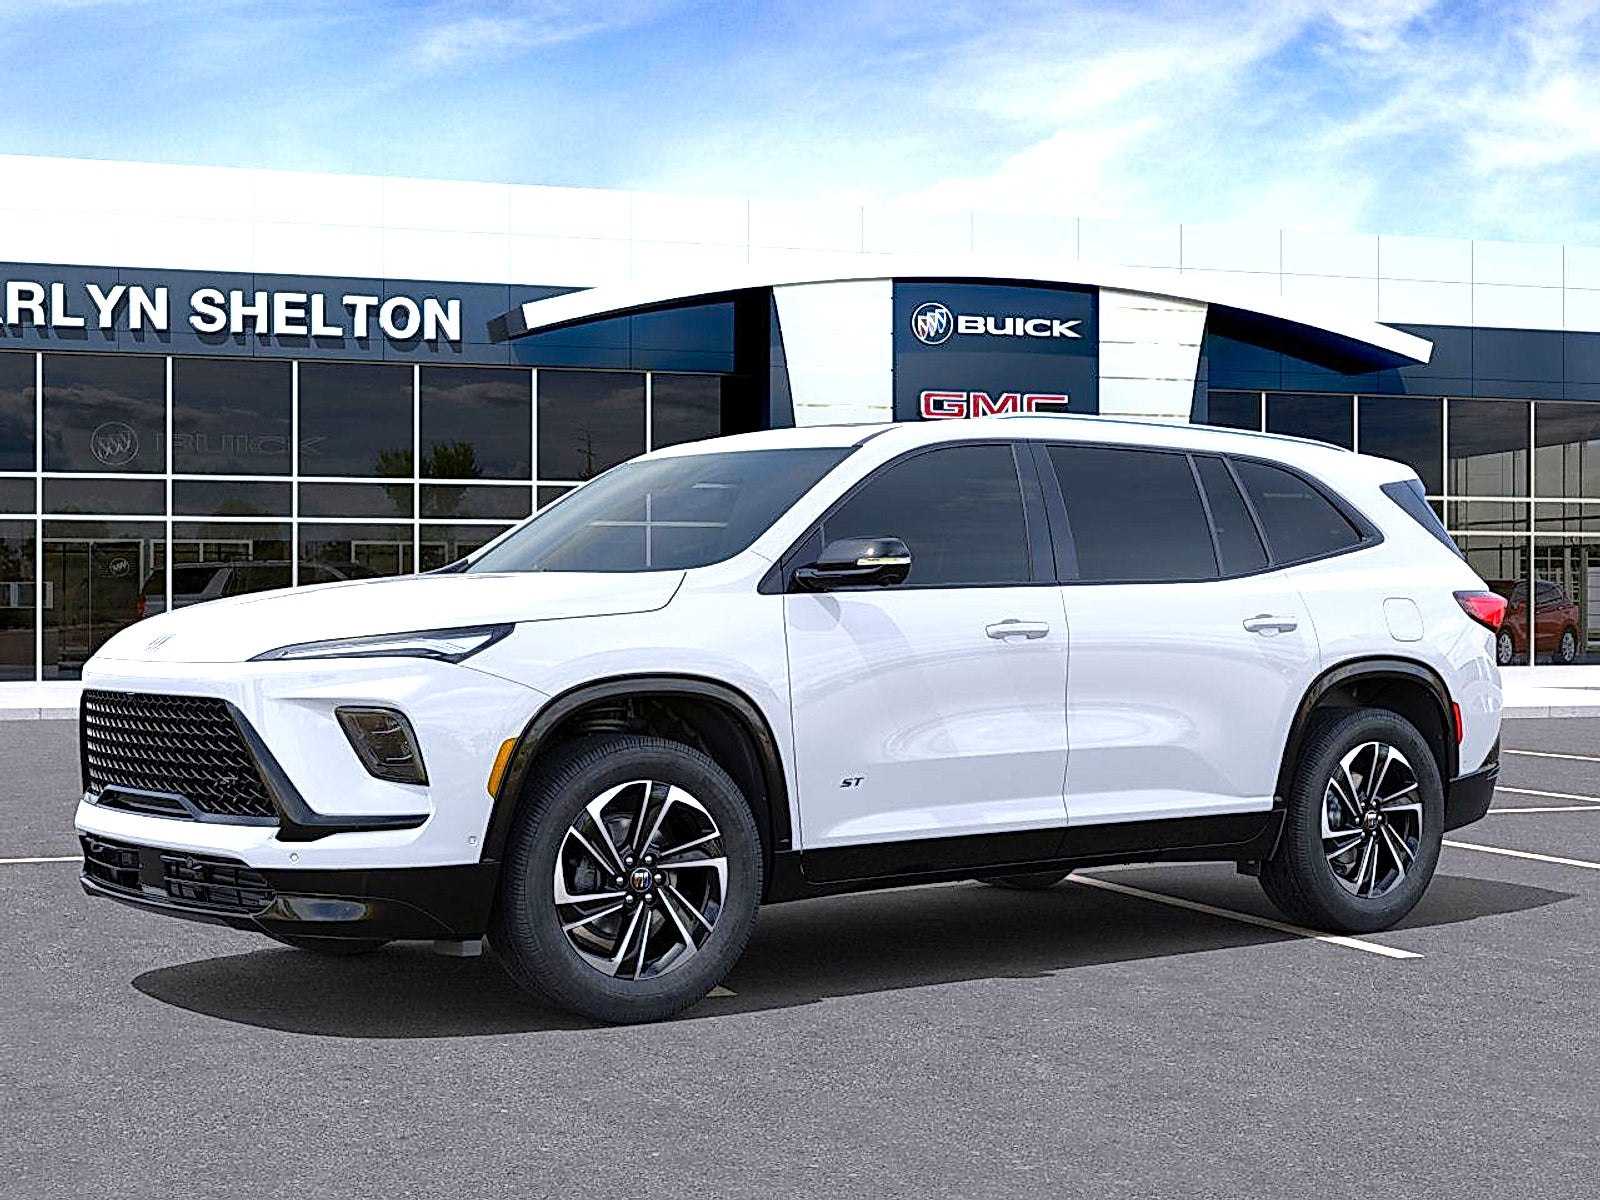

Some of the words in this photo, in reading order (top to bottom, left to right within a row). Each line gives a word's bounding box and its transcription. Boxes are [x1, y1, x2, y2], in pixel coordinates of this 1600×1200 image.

[0, 281, 168, 330] RLYN
[189, 288, 461, 341] SHELTON
[957, 315, 1082, 338] BUICK
[920, 391, 1068, 419] GMC
[840, 777, 865, 788] ST
